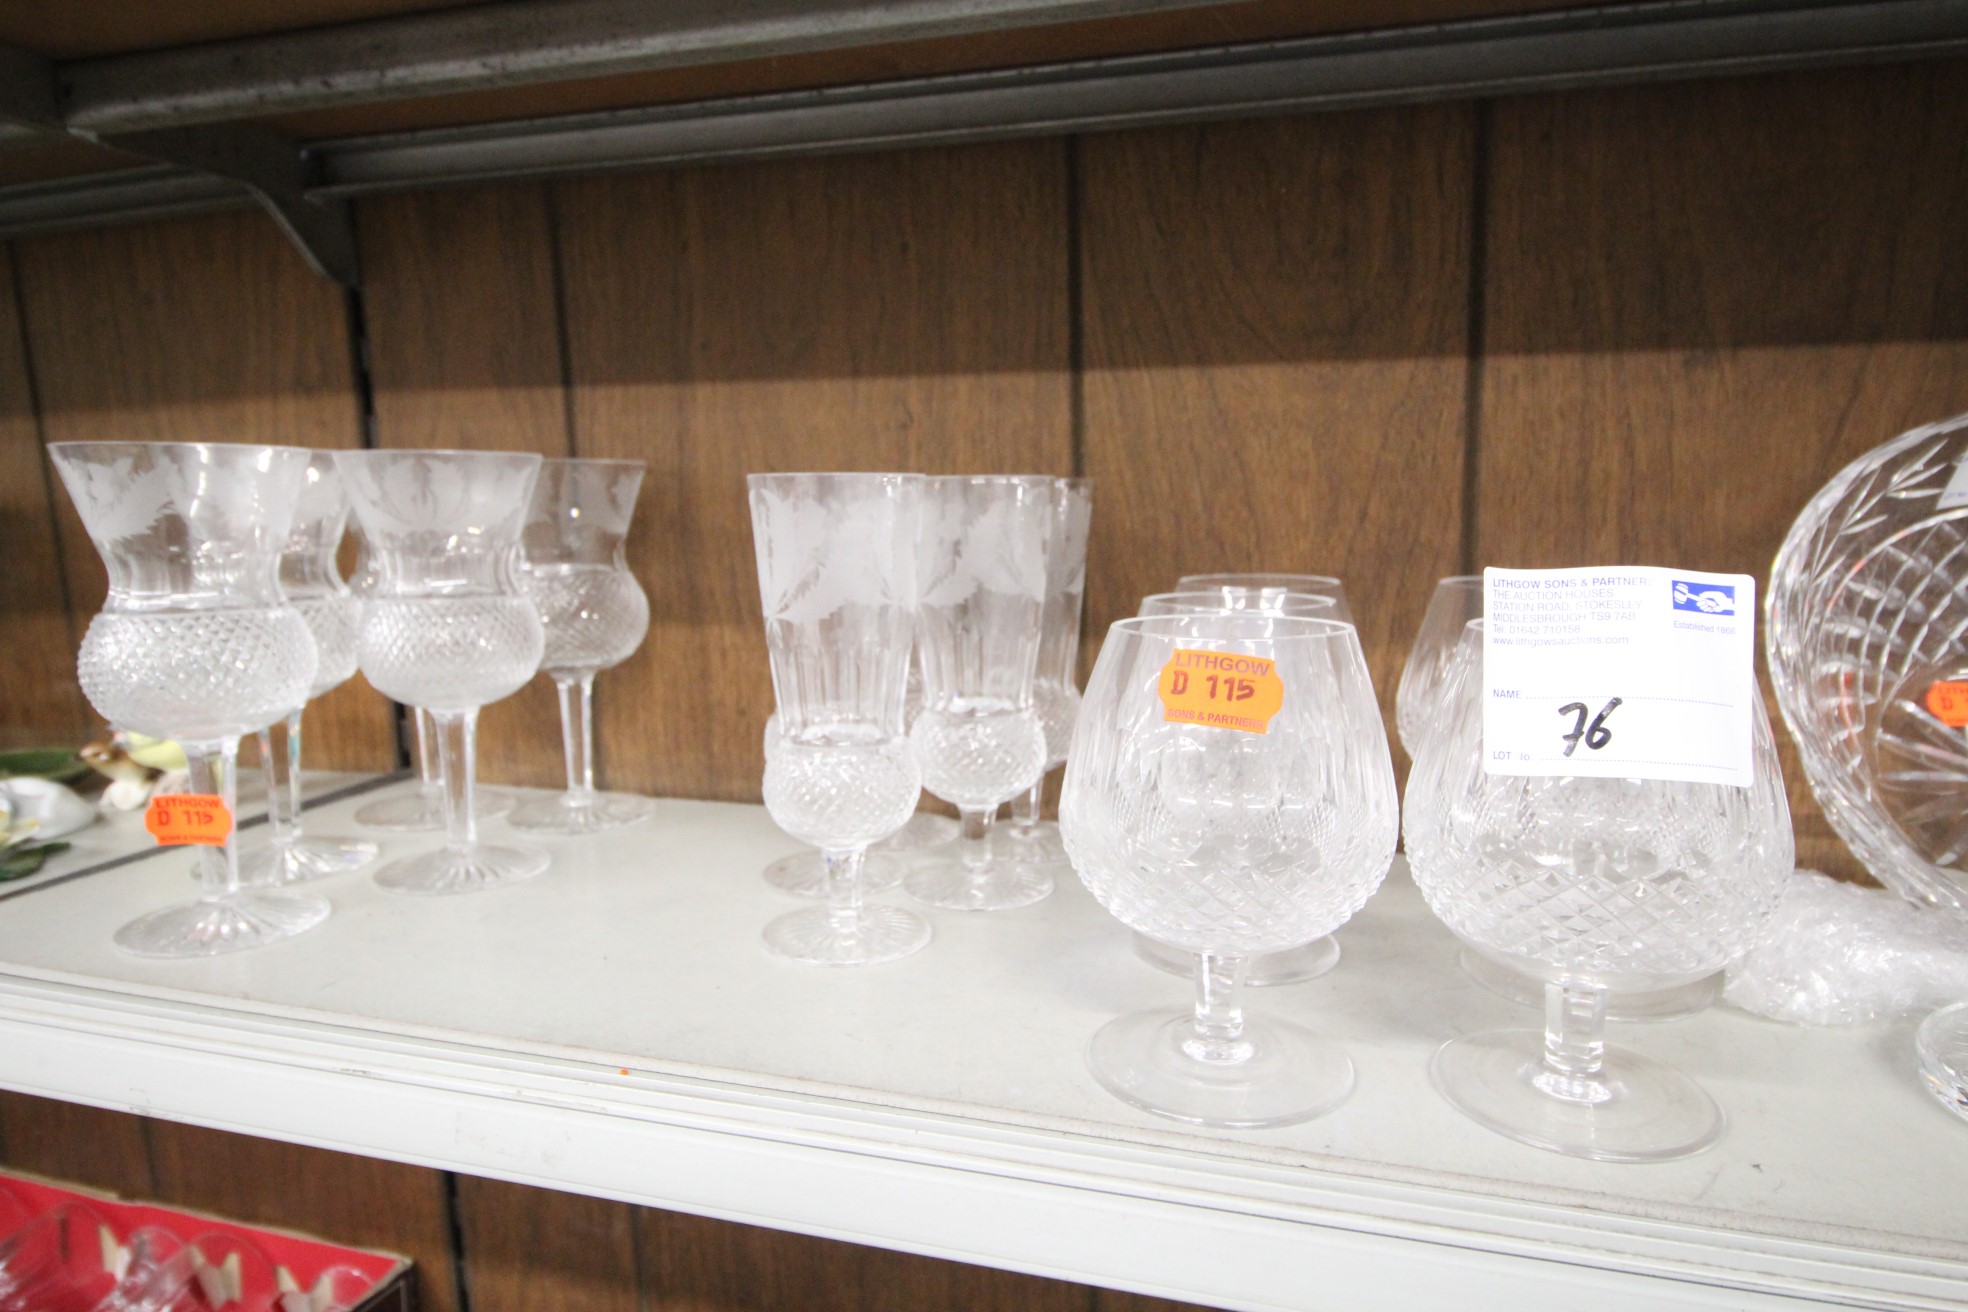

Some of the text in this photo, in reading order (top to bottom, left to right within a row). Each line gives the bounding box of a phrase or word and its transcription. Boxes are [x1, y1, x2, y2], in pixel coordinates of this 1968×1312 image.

[1493, 577, 1652, 589] LITHGOW SONS & PARTNER
[1493, 588, 1614, 600] THE AUCTION HOUSES
[1493, 600, 1534, 611] STATION
[1575, 600, 1643, 610] STOKESLEY
[1493, 611, 1636, 623] MIDDLESBROUGH TS9 7AB
[1509, 625, 1540, 635] 01642
[1543, 624, 1581, 634] 710158
[1673, 620, 1715, 633] Established
[1493, 636, 1629, 648] www.lithgowsauctions.com
[1174, 653, 1271, 677] LITHGOW
[1170, 669, 1255, 702] D 115
[1493, 688, 1522, 699] NAME
[1168, 708, 1264, 730] SONS & PARTNERS
[1557, 697, 1623, 758] 76
[1493, 750, 1512, 760] LOT
[157, 809, 171, 827] D
